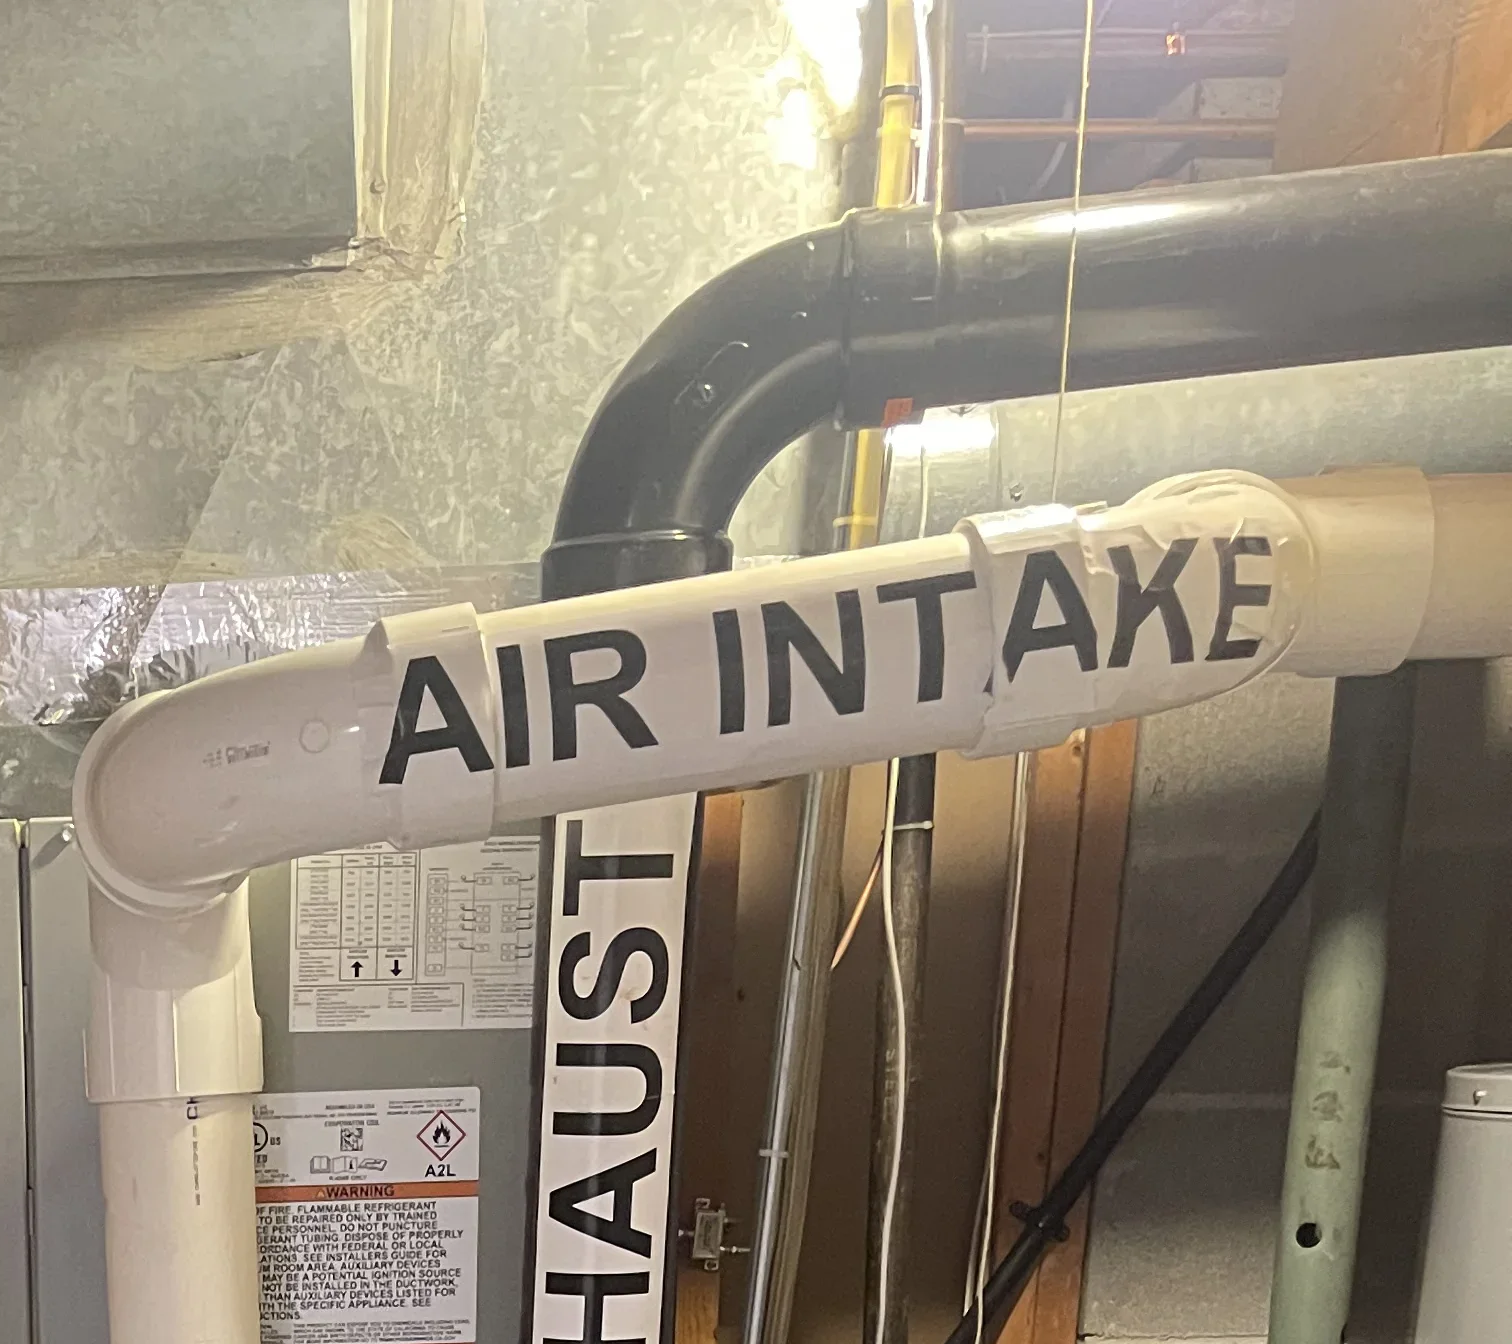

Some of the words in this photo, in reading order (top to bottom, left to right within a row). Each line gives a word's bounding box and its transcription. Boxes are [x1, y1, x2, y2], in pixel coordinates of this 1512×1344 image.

[377, 627, 659, 786] AIR
[712, 535, 1274, 735] INTAKE
[425, 1164, 456, 1177] A2L
[326, 1184, 394, 1199] WARNING
